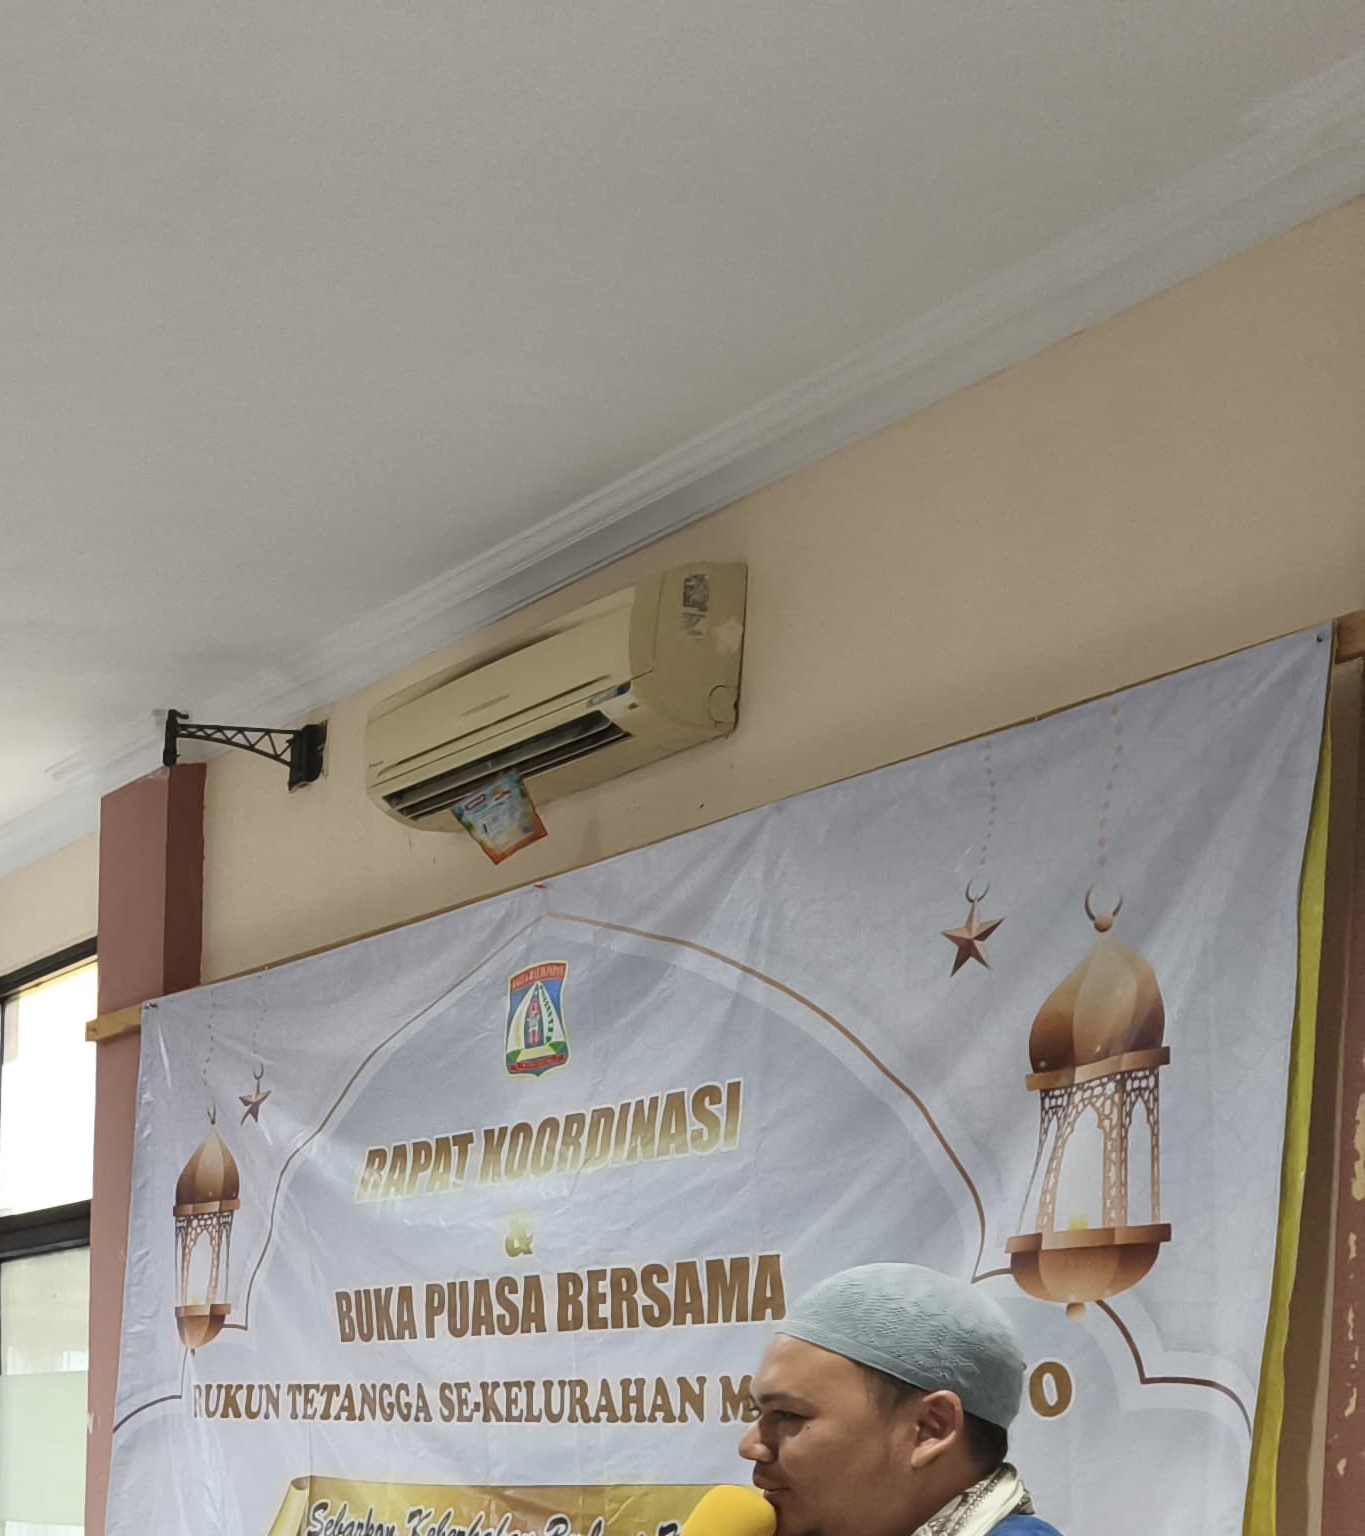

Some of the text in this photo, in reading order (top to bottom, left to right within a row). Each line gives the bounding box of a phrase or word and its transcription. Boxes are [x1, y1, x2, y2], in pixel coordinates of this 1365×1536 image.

[355, 1080, 743, 1201] RAPAT KOORDINASI
[504, 1209, 534, 1258] &
[335, 1253, 788, 1343] BUKA PUASA BERSAMA
[193, 1382, 281, 1421] RUKUN
[286, 1381, 433, 1423] TETANGGA
[439, 1375, 708, 1424] SE-KELURAHAN
